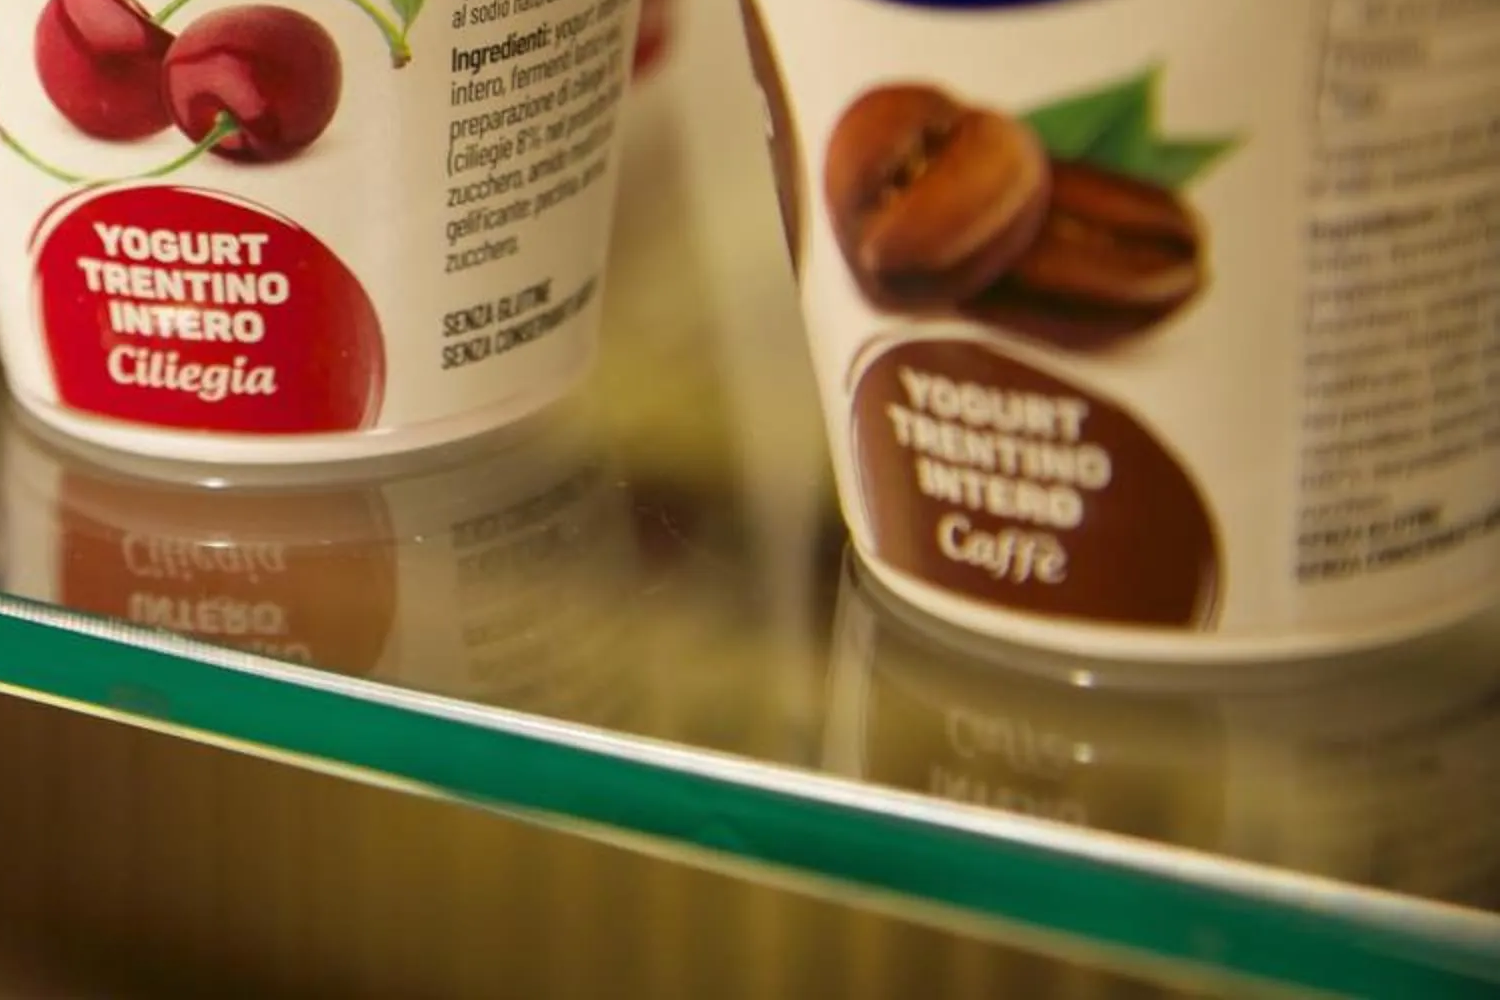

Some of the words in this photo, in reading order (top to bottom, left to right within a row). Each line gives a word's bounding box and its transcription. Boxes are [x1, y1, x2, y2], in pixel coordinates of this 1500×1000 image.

[452, 4, 467, 29] al
[452, 22, 552, 75] Ingredienti:
[451, 76, 507, 107] intero,
[450, 91, 555, 142] preparazione
[92, 222, 269, 265] YOGURT
[77, 257, 289, 304] TRENTINO
[108, 299, 265, 343] INTERO
[443, 303, 492, 337] SENZA
[107, 344, 278, 401] Ciliegia
[442, 335, 491, 370] SENZA
[899, 365, 1089, 442] YOGURT
[886, 402, 1111, 490] TRENTINO
[916, 454, 1083, 529] INTERO
[936, 512, 1068, 584] Caffè
